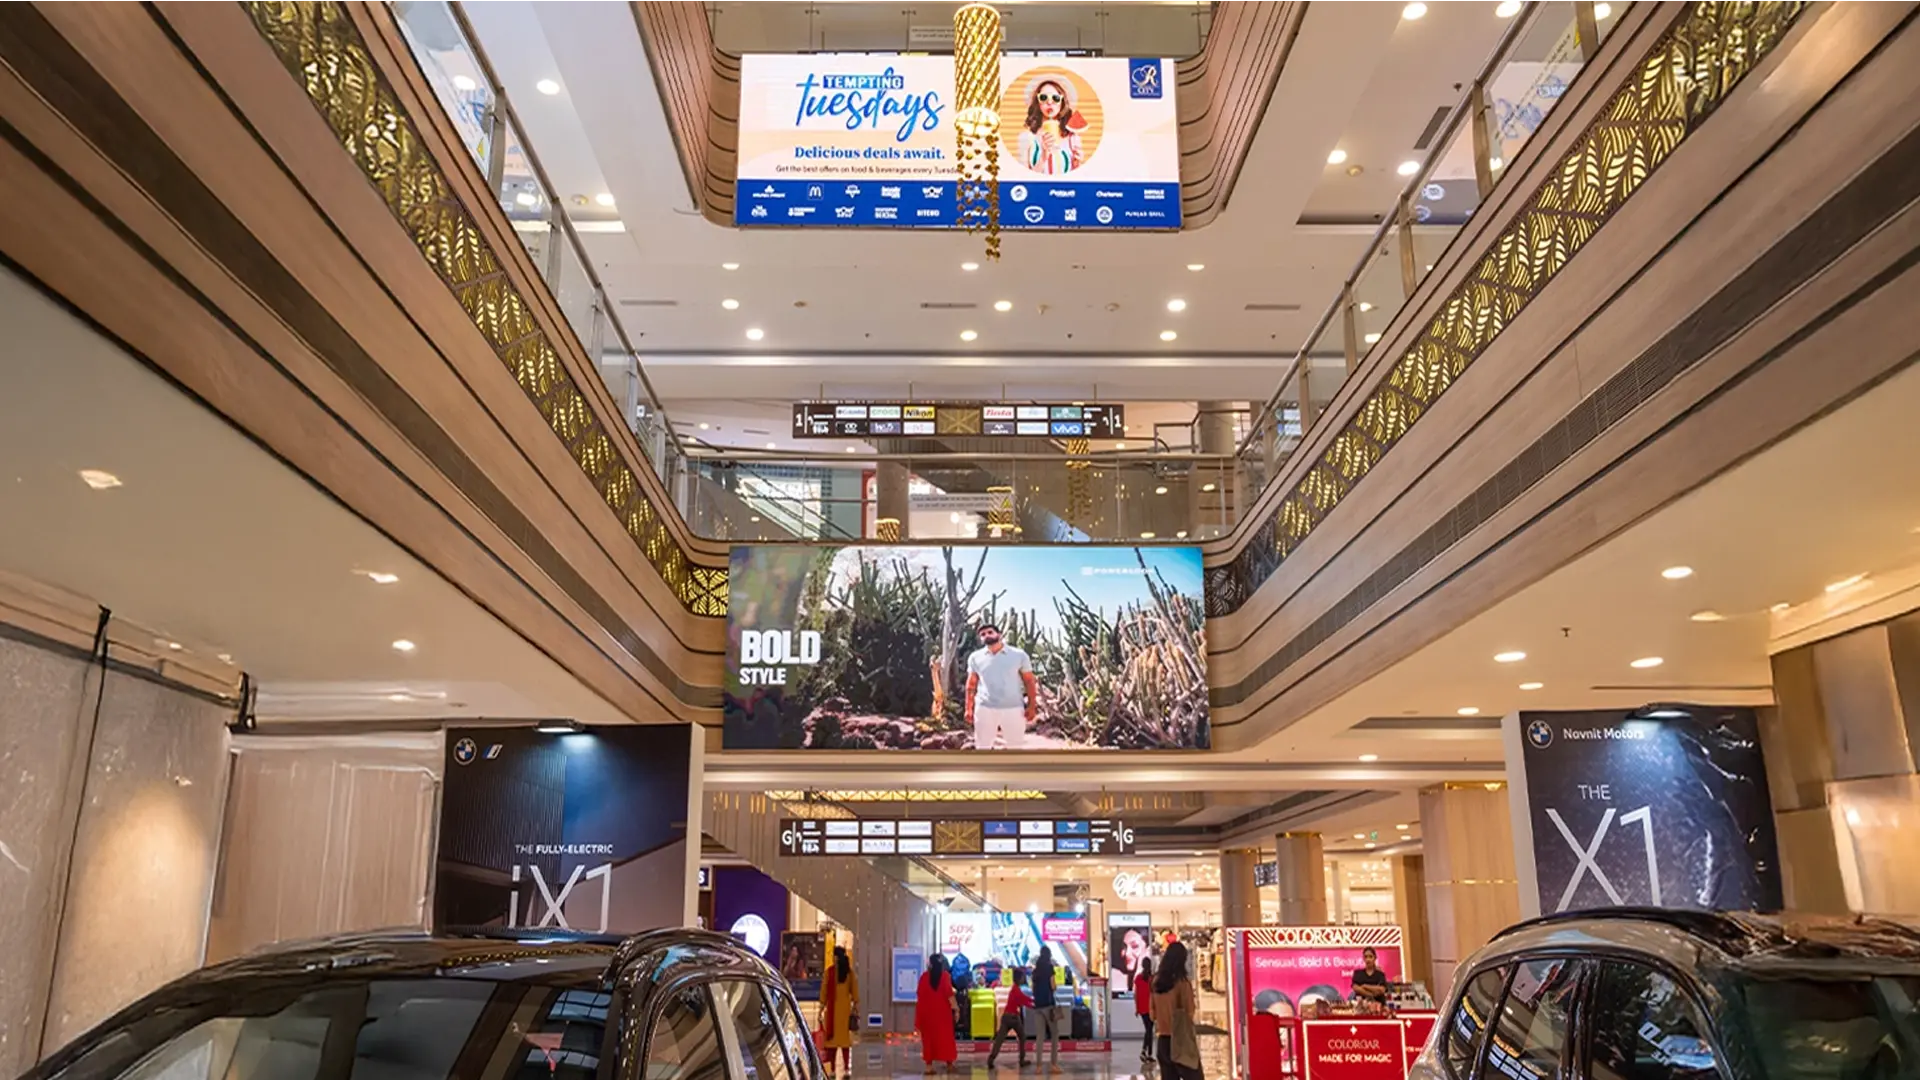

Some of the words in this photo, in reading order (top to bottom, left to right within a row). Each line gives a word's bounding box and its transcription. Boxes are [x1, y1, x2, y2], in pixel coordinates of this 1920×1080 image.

[825, 76, 903, 89] TEMPTING
[795, 146, 860, 160] Delicious
[863, 147, 900, 160] deals
[903, 148, 945, 160] await.
[776, 164, 789, 173] Get
[790, 164, 801, 173] the
[803, 164, 818, 173] best
[820, 164, 839, 173] offers
[851, 165, 867, 174] food
[869, 166, 874, 174] &
[876, 166, 911, 175] beverages
[913, 168, 932, 176] every
[796, 413, 803, 427] 1
[1115, 415, 1121, 428] 1
[741, 629, 821, 665] BOLD
[740, 667, 786, 685] STYLE
[1563, 728, 1601, 739] Navnit
[1604, 728, 1644, 740] Motors
[1578, 785, 1611, 799] THE
[782, 830, 792, 846] G
[1123, 828, 1134, 844] G
[515, 844, 533, 854] THE
[536, 844, 613, 854] FULLY-ELECTRIC
[1545, 805, 1662, 913] X1
[508, 862, 612, 934] iX1
[949, 924, 974, 934] 50%
[1255, 957, 1297, 969] Sensual,
[1299, 957, 1321, 968] Bold
[1323, 958, 1331, 967] &
[1319, 1053, 1343, 1063] MADE
[1345, 1053, 1363, 1063] FOR
[1364, 1053, 1392, 1063] MAGIC
